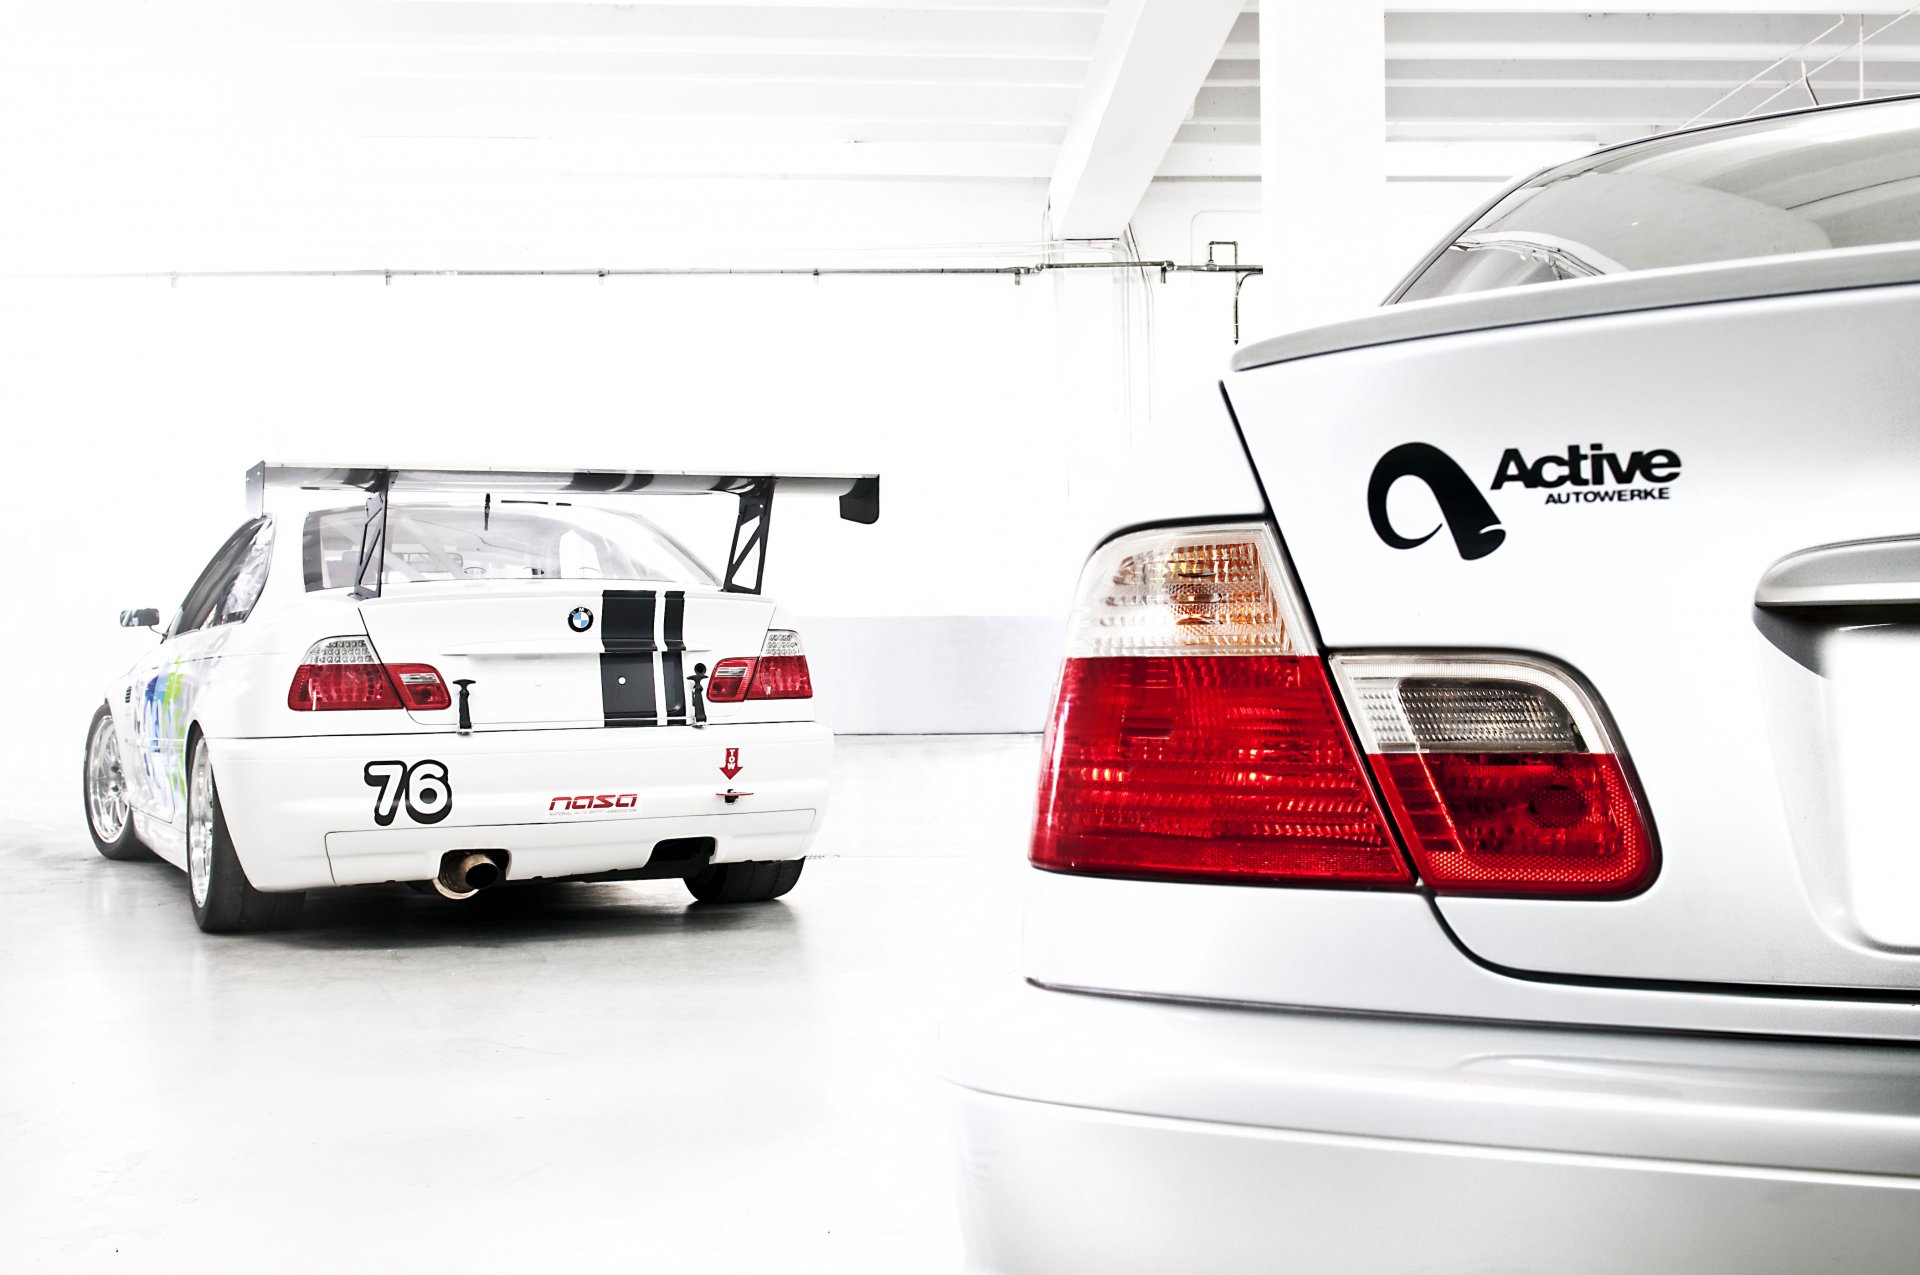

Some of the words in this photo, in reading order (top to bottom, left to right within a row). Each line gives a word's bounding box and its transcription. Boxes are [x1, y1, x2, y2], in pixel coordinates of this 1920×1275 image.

[1490, 443, 1682, 489] Active
[1545, 487, 1670, 504] AUTOWERKE
[728, 749, 736, 769] TOW
[364, 759, 452, 826] 76
